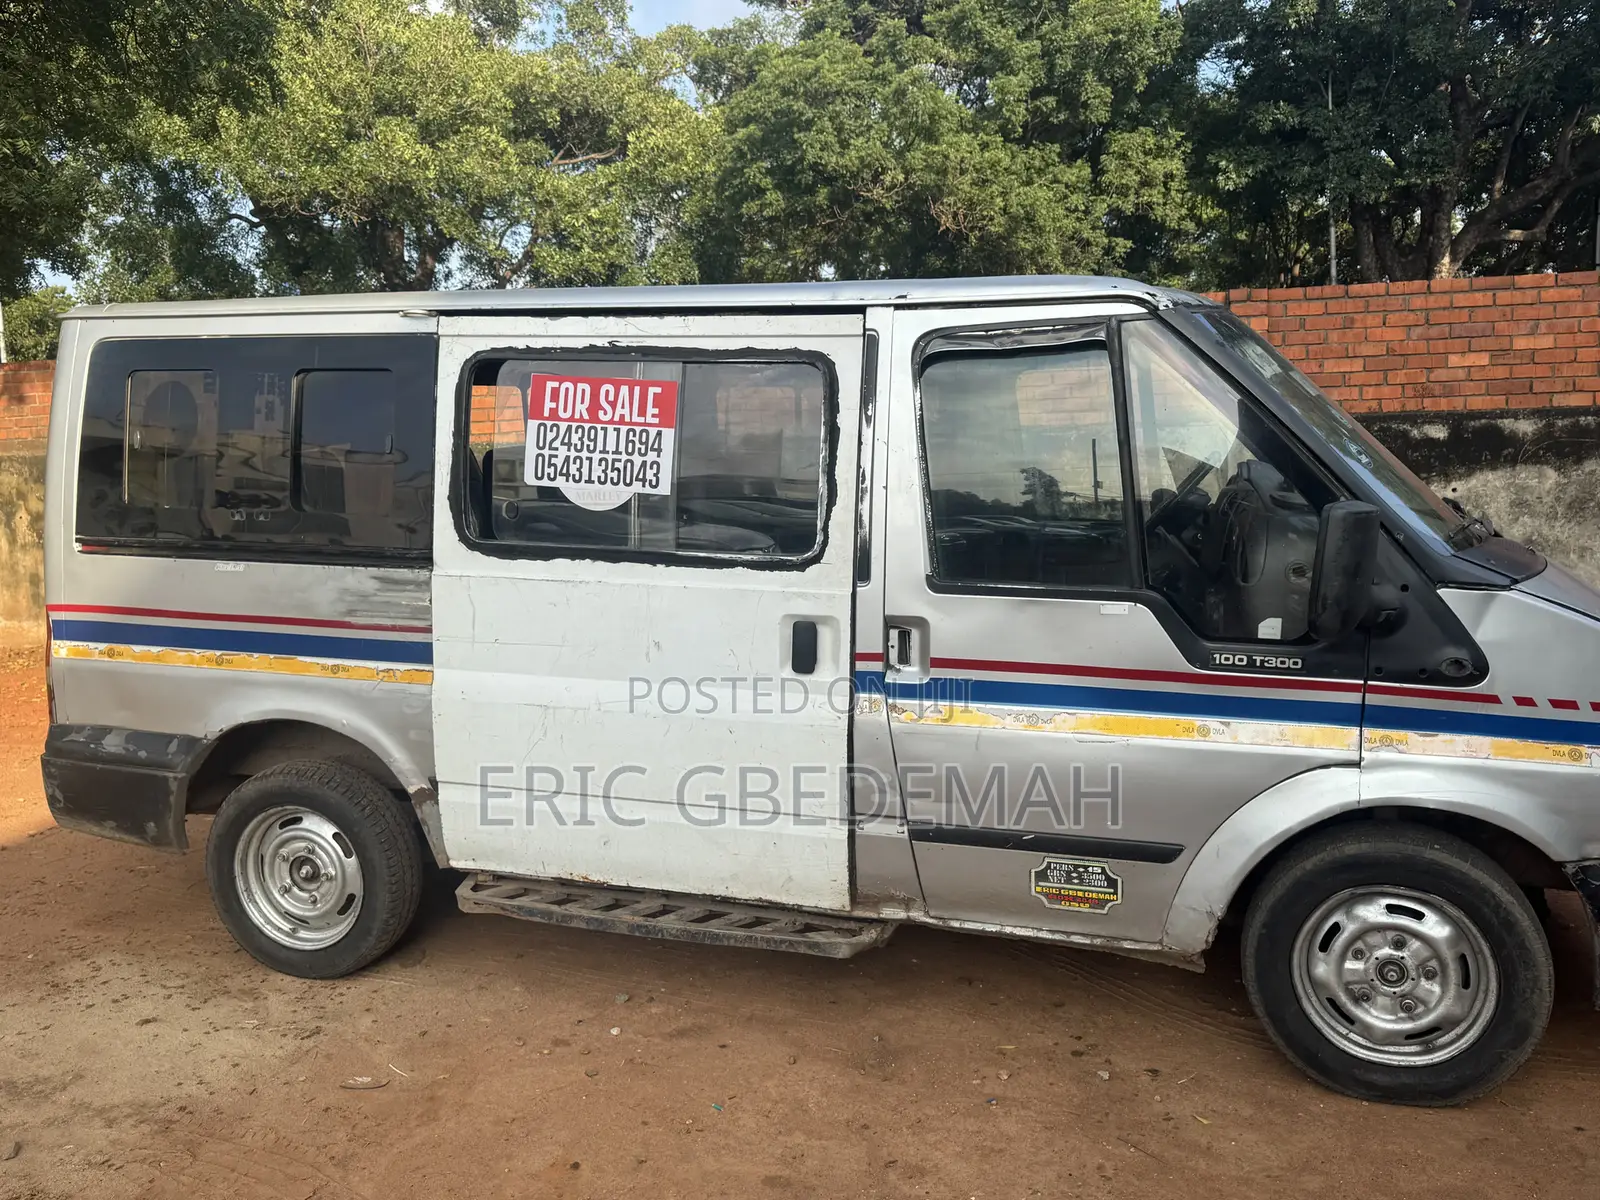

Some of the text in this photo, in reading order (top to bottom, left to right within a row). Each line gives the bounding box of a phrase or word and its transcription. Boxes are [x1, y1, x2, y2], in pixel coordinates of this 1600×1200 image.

[543, 381, 662, 424] FOR SALE
[535, 422, 663, 458] 0243911694
[534, 452, 661, 489] 0543135043
[1213, 653, 1302, 669] 100 T300
[1364, 736, 1409, 746] DVLA DVLA
[1552, 749, 1567, 757] DVLA
[1051, 862, 1074, 871] PERS
[1035, 886, 1117, 900] ERIC GBEDEMAH
